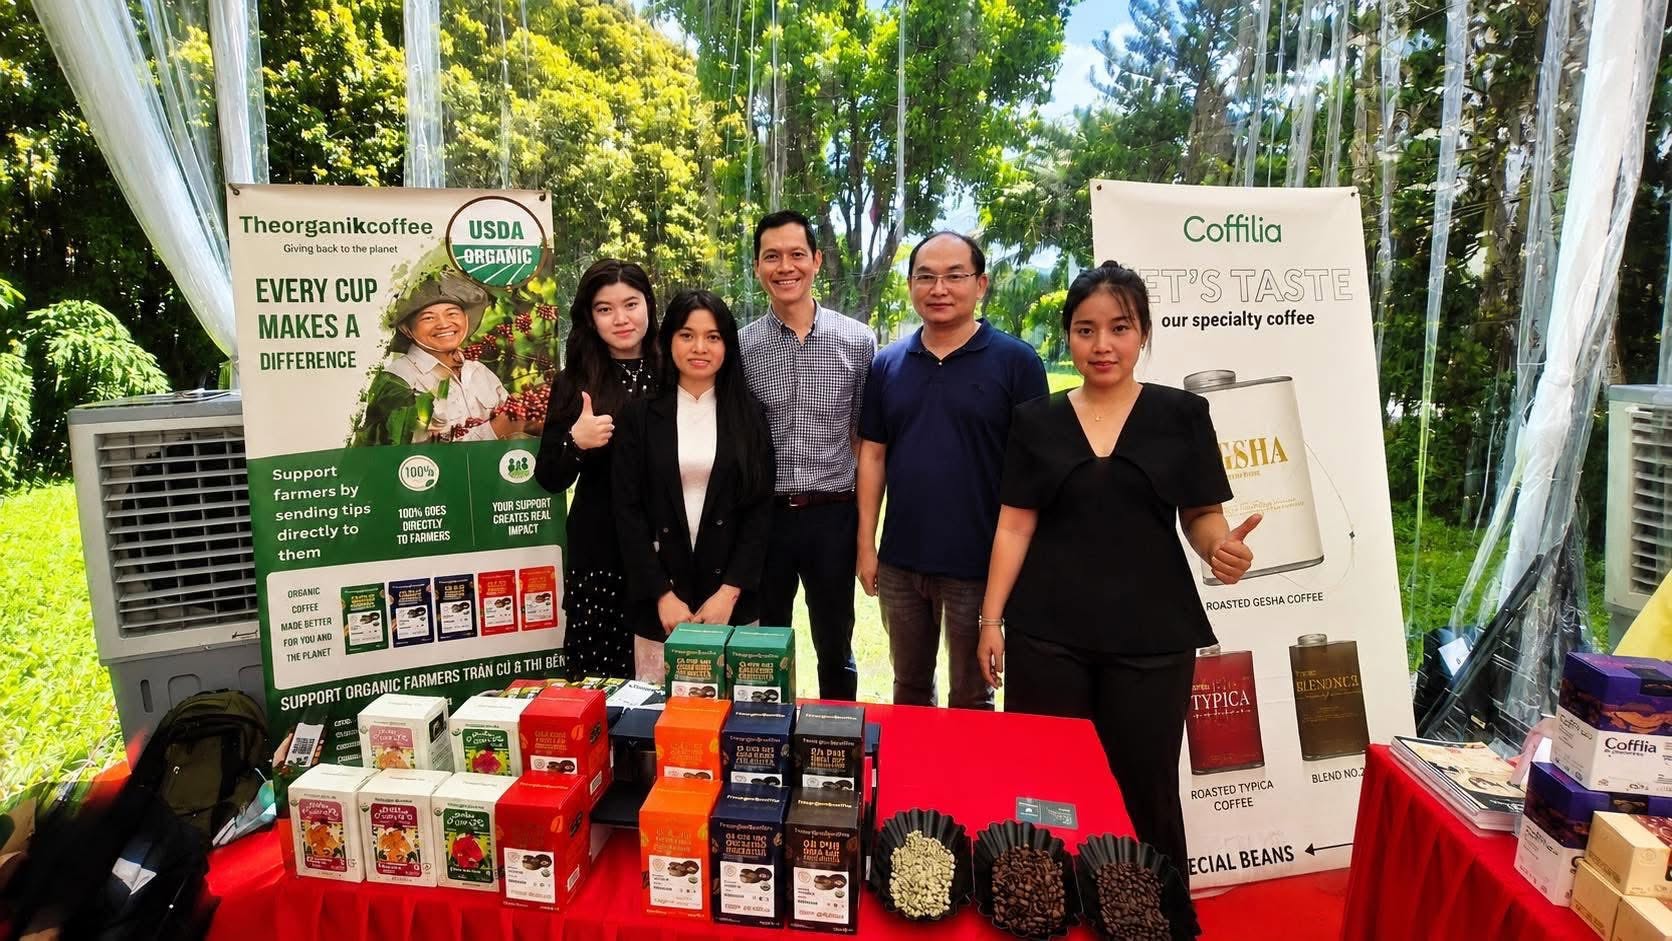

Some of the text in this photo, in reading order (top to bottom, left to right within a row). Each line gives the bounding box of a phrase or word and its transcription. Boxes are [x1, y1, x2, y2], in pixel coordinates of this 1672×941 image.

[239, 215, 433, 238] Theorganikcoffee
[469, 220, 525, 240] USDA
[1184, 213, 1282, 243] Coffilia
[283, 243, 398, 255] Giving back to the planet
[464, 249, 532, 265] ORGANIC
[255, 278, 378, 303] EVERY CUP
[1139, 268, 1353, 303] ET'S TASTE
[258, 313, 361, 339] MAKES A
[1161, 310, 1315, 331] our specialty coffee
[260, 351, 356, 370] DIFFERENCE
[272, 466, 338, 483] Support
[274, 483, 359, 501] farmers by
[275, 502, 371, 521] sending tips
[398, 505, 447, 519] 100% GOES
[492, 497, 552, 512] YOUR SUPPORT
[402, 518, 443, 532] DIRECTLY
[493, 510, 552, 525] CREATES REAL
[277, 523, 359, 542] directly to
[396, 531, 451, 545] TO FARMERS
[508, 523, 539, 536] IMPACT
[278, 547, 321, 562] them
[288, 587, 320, 599] ORGANIC
[1206, 592, 1324, 611] ROASTED GESHA COFFEE
[292, 602, 319, 614] COFFEE
[281, 617, 332, 632] MADE BETTER
[283, 633, 332, 647] FOR YOU AND
[287, 647, 331, 662] THE PLANET
[280, 687, 342, 711] SUPPORT
[345, 677, 401, 700] ORGANIC
[404, 669, 460, 690] FARMERS
[514, 661, 521, 673] &
[523, 658, 542, 672] THI
[1191, 690, 1250, 710] TYPICA
[1311, 770, 1342, 783] BLEND
[1191, 780, 1274, 800] ROASTED TYPICA
[1214, 797, 1254, 811] COFFEE
[1188, 845, 1294, 875] ECIAL BEANS
